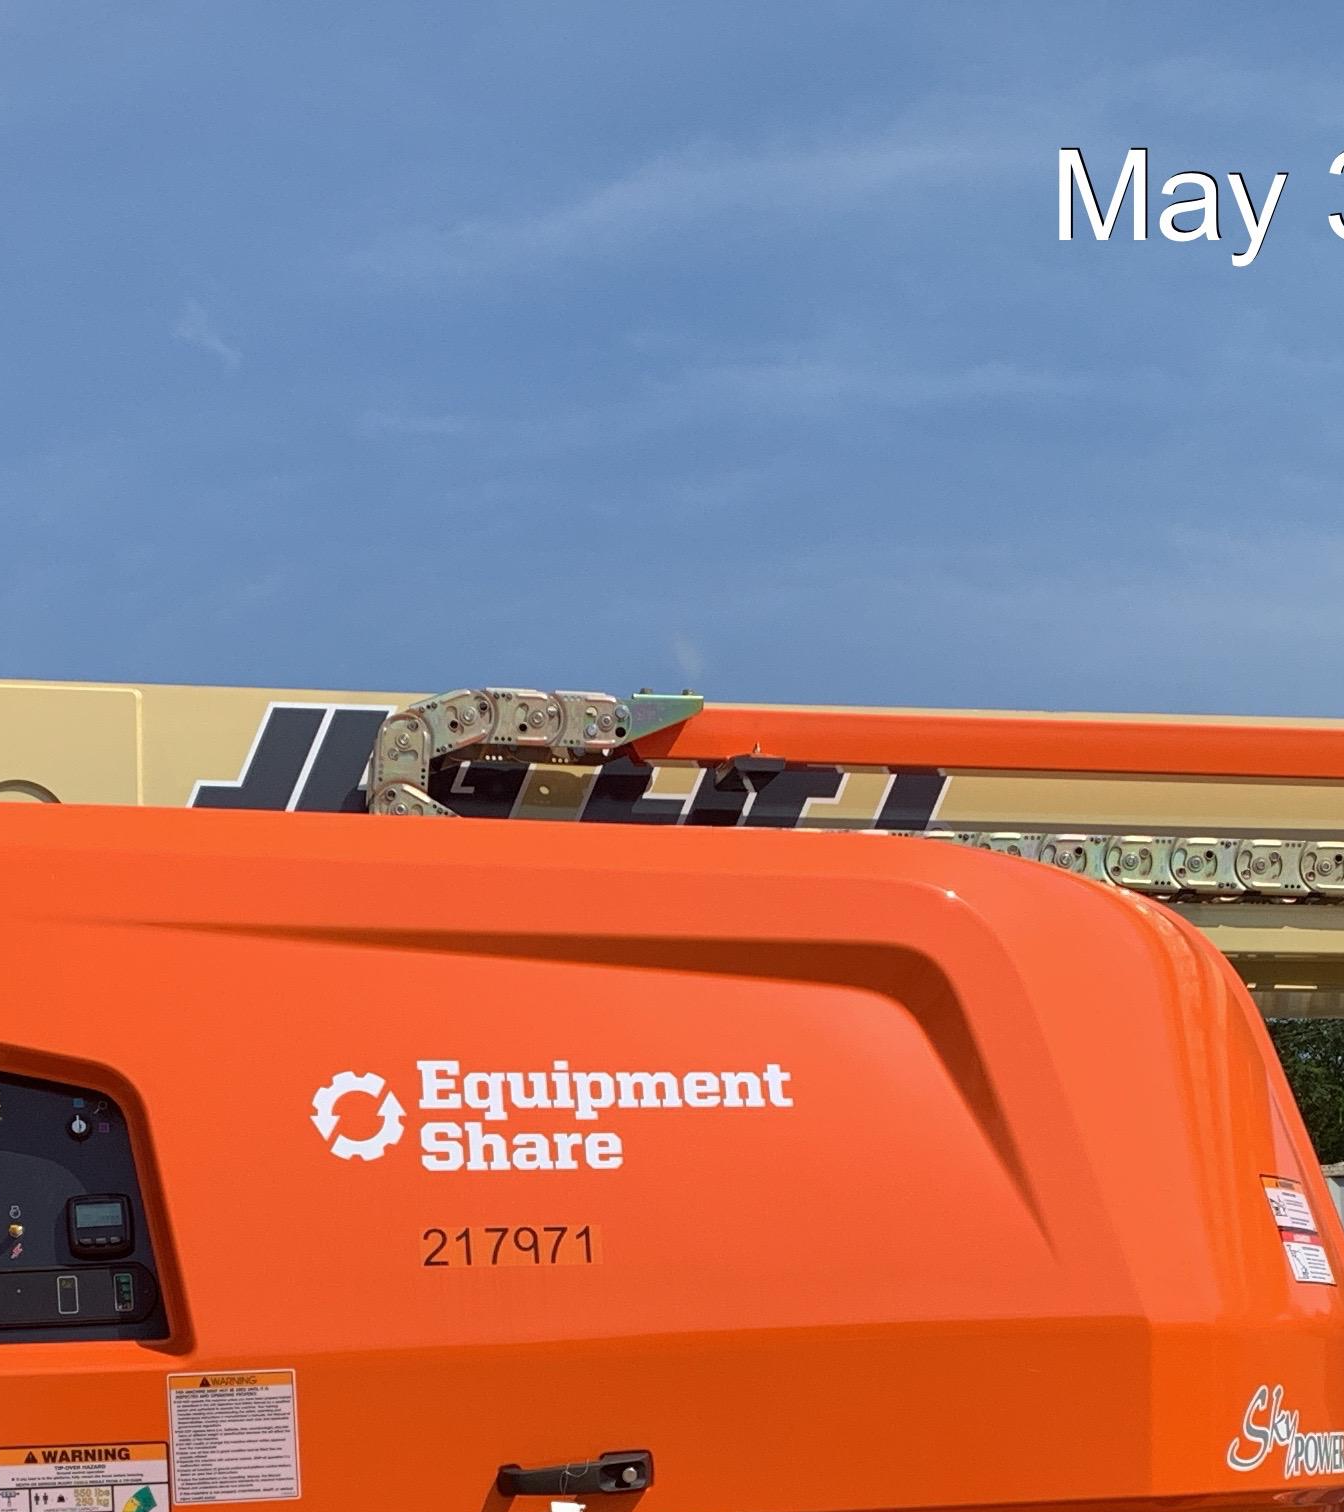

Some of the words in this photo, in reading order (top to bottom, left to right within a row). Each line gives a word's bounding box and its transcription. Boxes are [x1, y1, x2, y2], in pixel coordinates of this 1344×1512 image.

[417, 1060, 794, 1120] Equipment
[419, 1121, 624, 1171] Share
[422, 1225, 594, 1266] 217971
[211, 1376, 257, 1386] WARNING
[1227, 1384, 1299, 1480] Sky
[42, 1448, 131, 1464] WARNING
